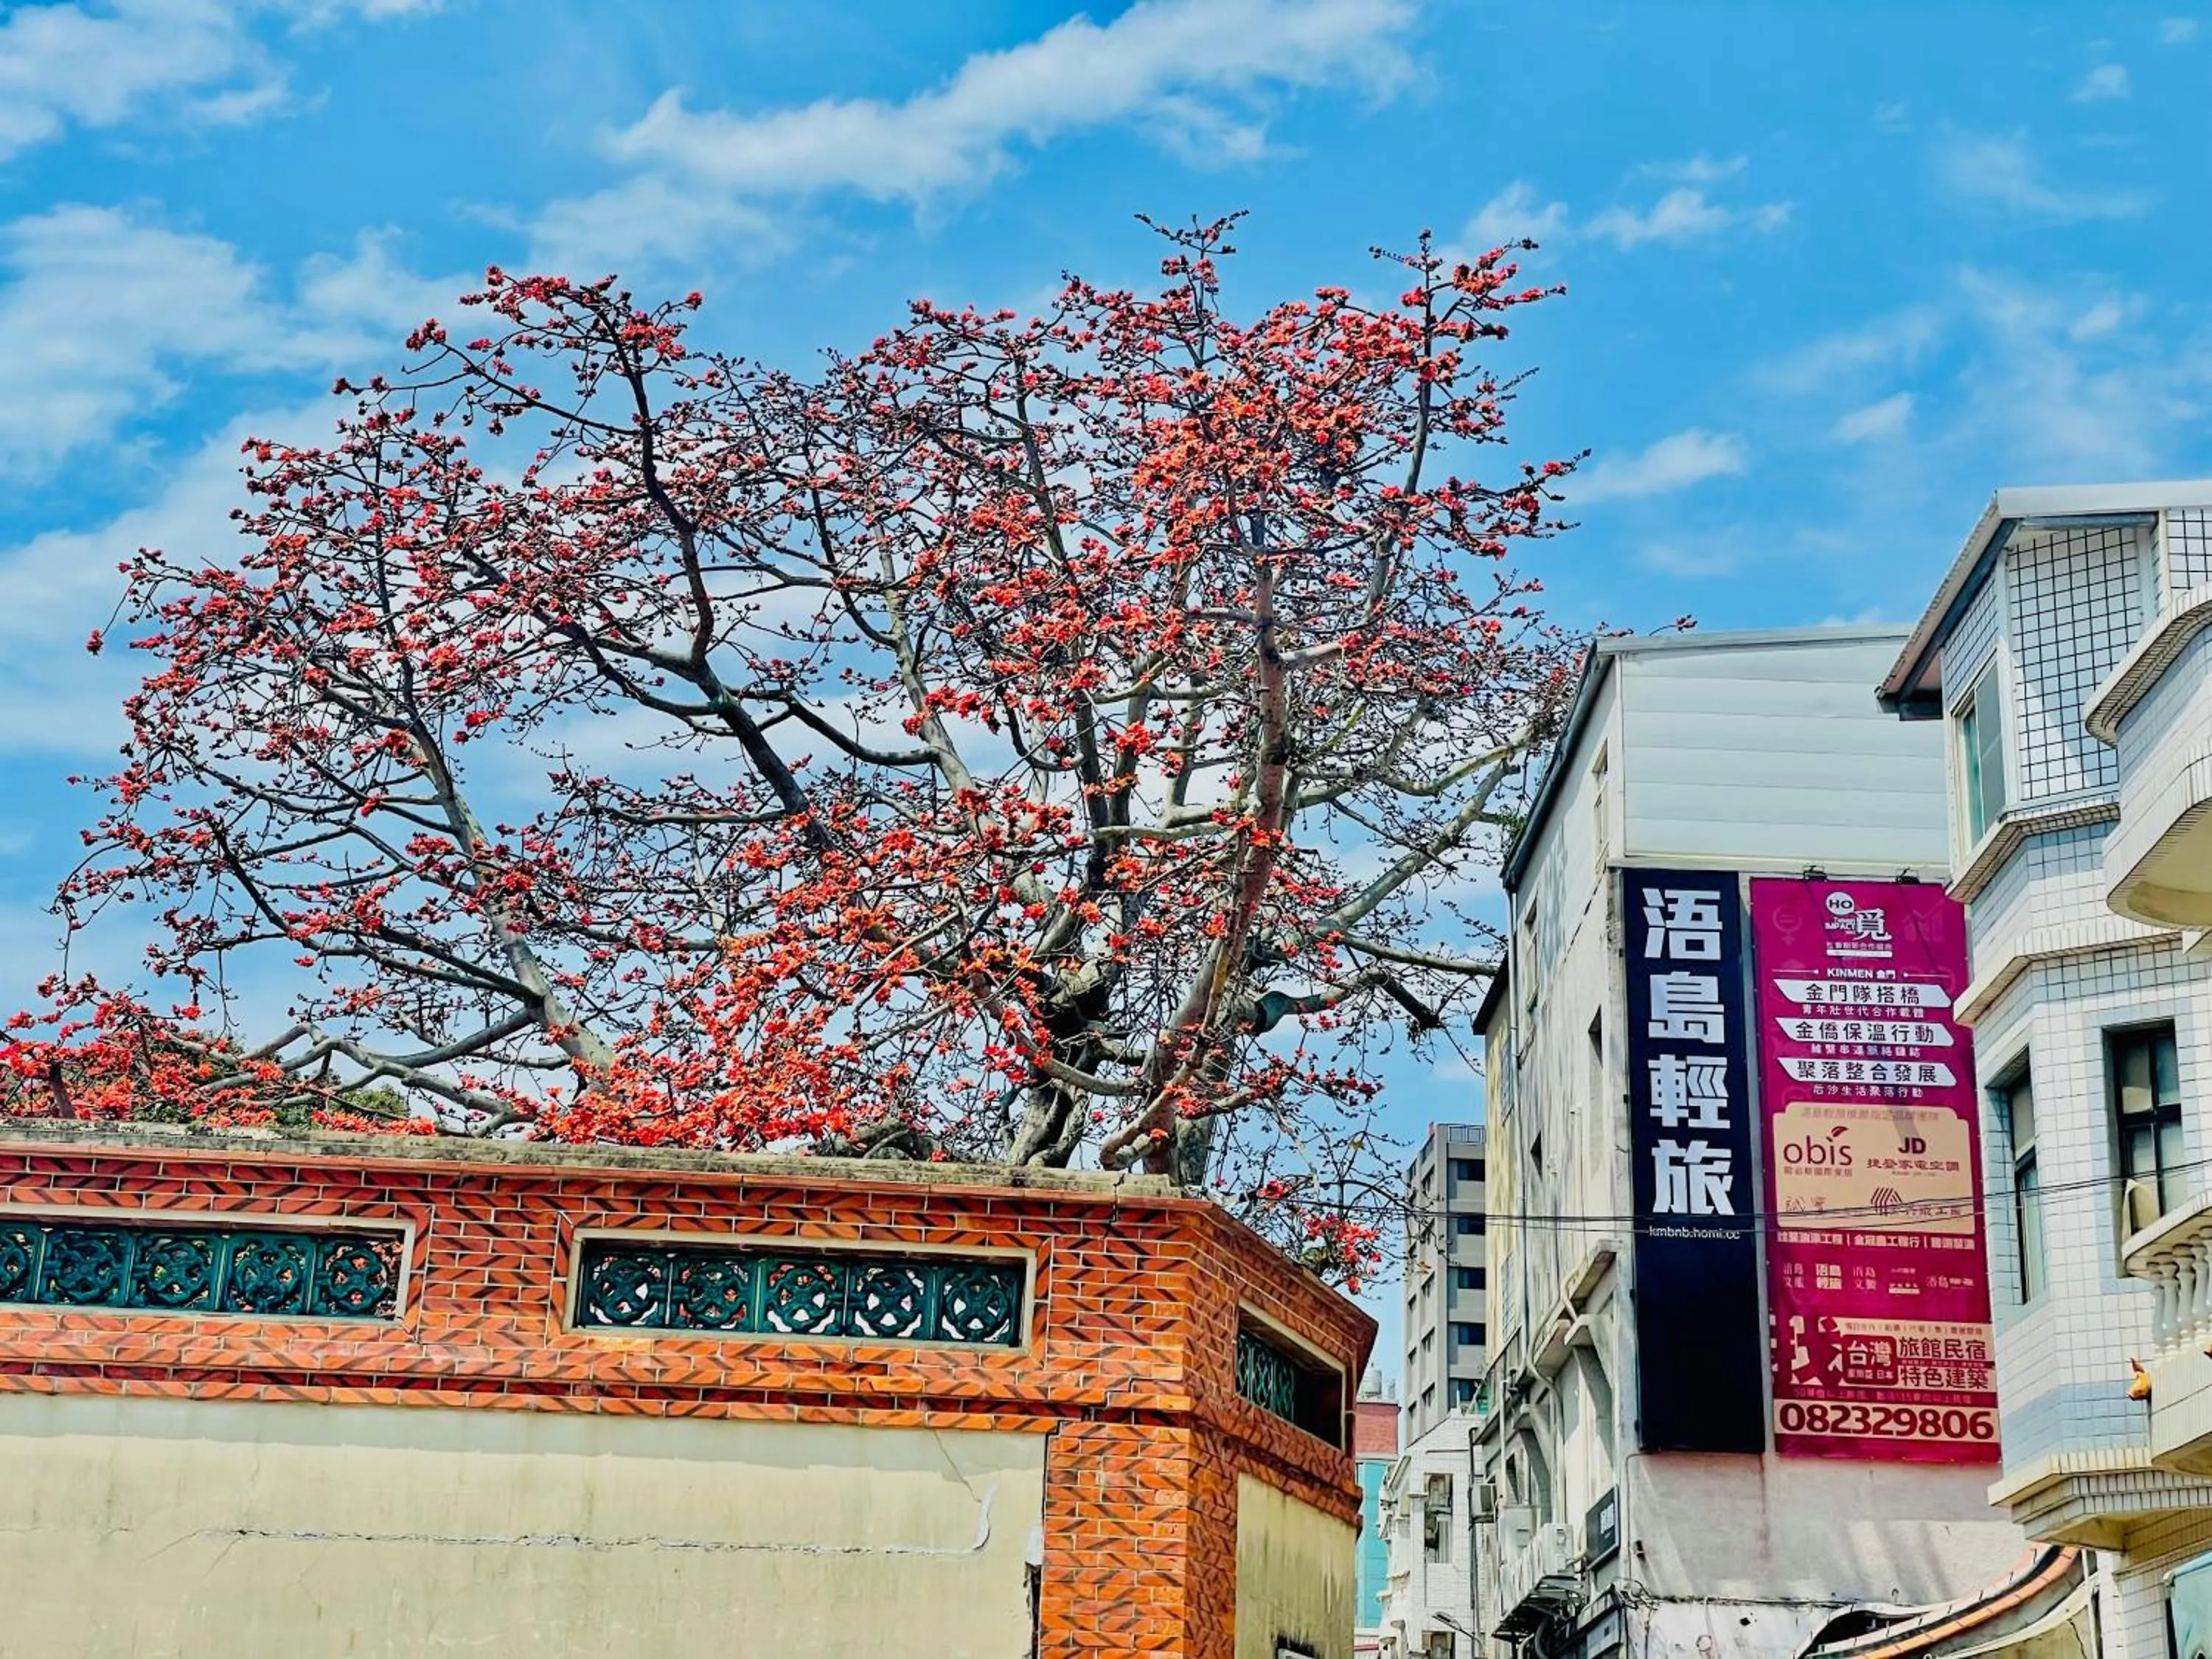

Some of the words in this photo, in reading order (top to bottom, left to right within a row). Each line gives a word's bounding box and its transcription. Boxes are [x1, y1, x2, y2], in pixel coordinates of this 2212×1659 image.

[1829, 900, 1853, 908] HO
[1827, 968, 1874, 978] KINMEN
[1876, 970, 1896, 979] 金門
[1806, 984, 1920, 1005] 金門隊搭橋
[1795, 1021, 1934, 1043] 金僑保溫行動
[1642, 887, 1735, 1216] 浯島輕旅
[1797, 1060, 1937, 1082] 聚落整合發展
[1784, 1135, 1853, 1166] obis
[1898, 1137, 1927, 1154] JD
[1848, 1339, 1891, 1366] 台灣
[1899, 1336, 1986, 1360] 旅館民宿
[1900, 1367, 1989, 1389] 特色建築
[1779, 1402, 1994, 1440] 082329806
